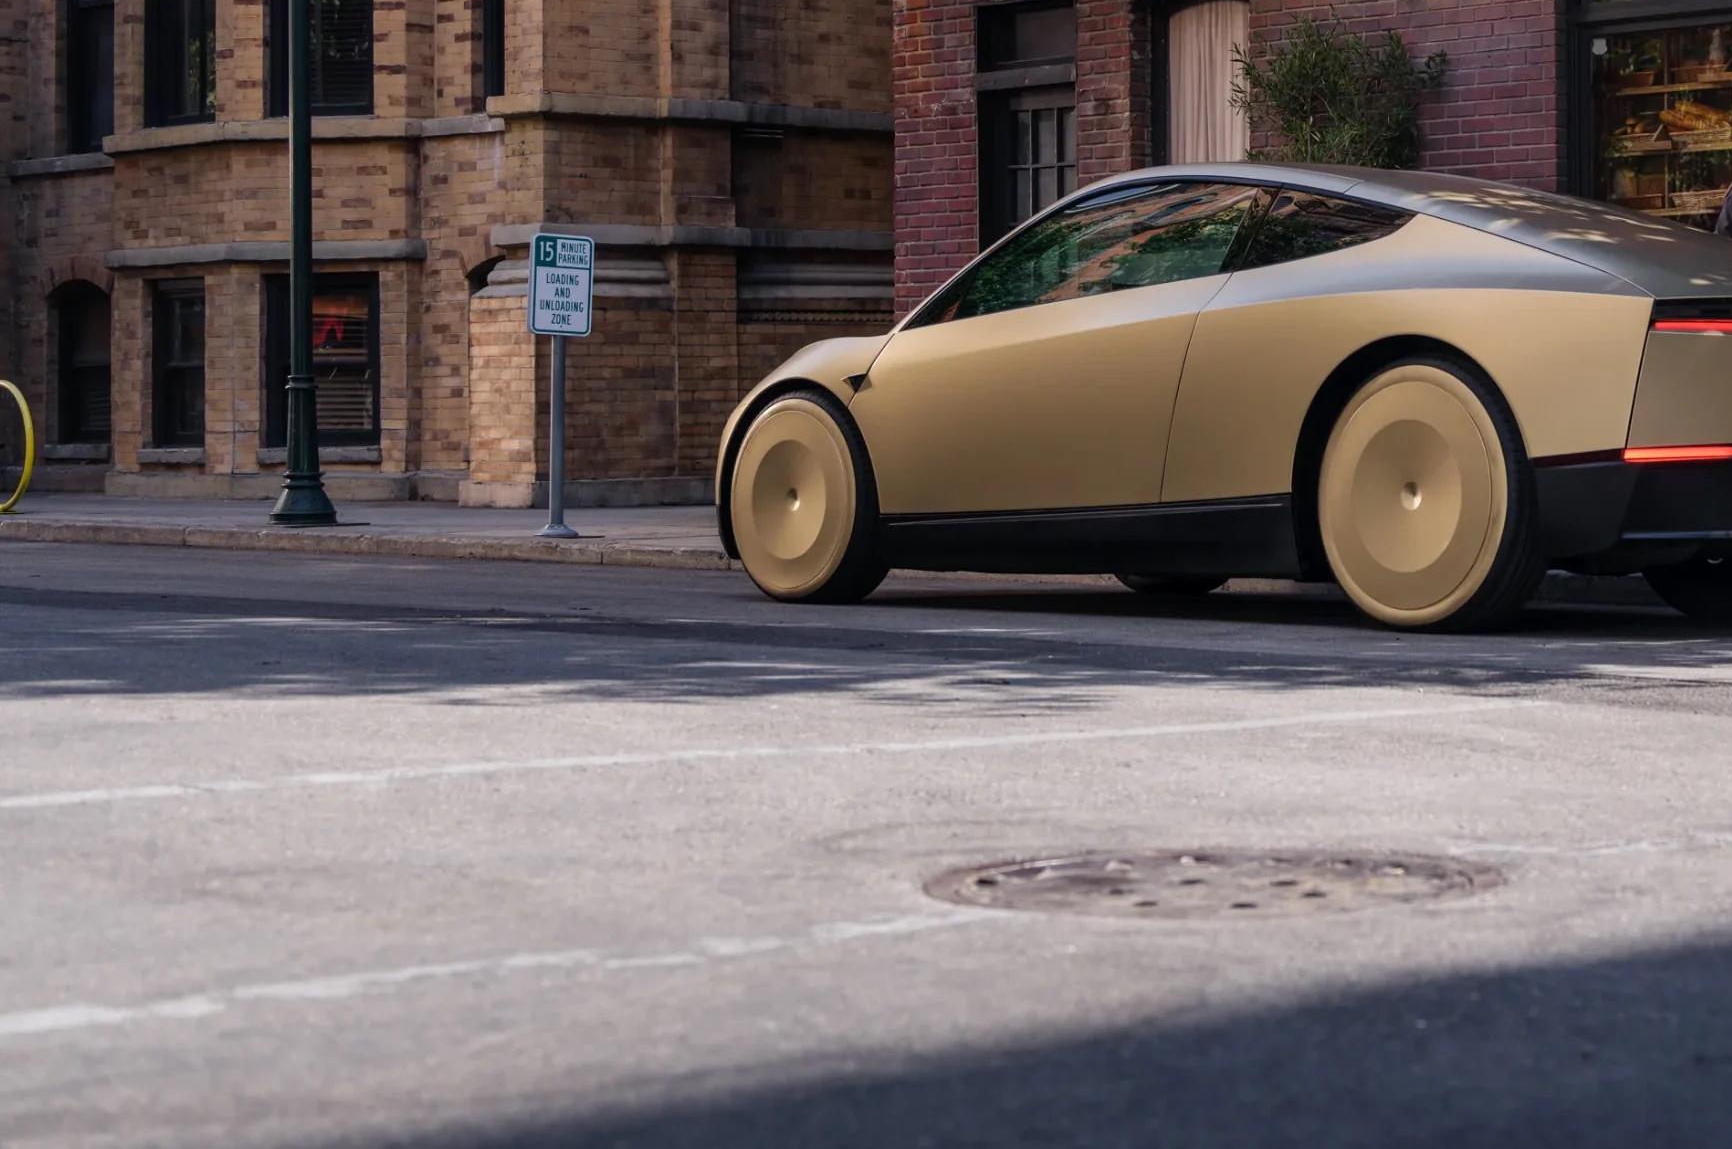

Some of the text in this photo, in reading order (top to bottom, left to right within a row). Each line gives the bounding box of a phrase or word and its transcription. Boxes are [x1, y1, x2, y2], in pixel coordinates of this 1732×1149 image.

[540, 241, 554, 262] 15
[561, 242, 586, 254] MINUTE
[558, 253, 588, 266] PARKING
[546, 274, 579, 285] LOADING
[554, 287, 570, 298] AND
[540, 299, 584, 312] UNLOADING
[551, 313, 571, 325] ZONE
